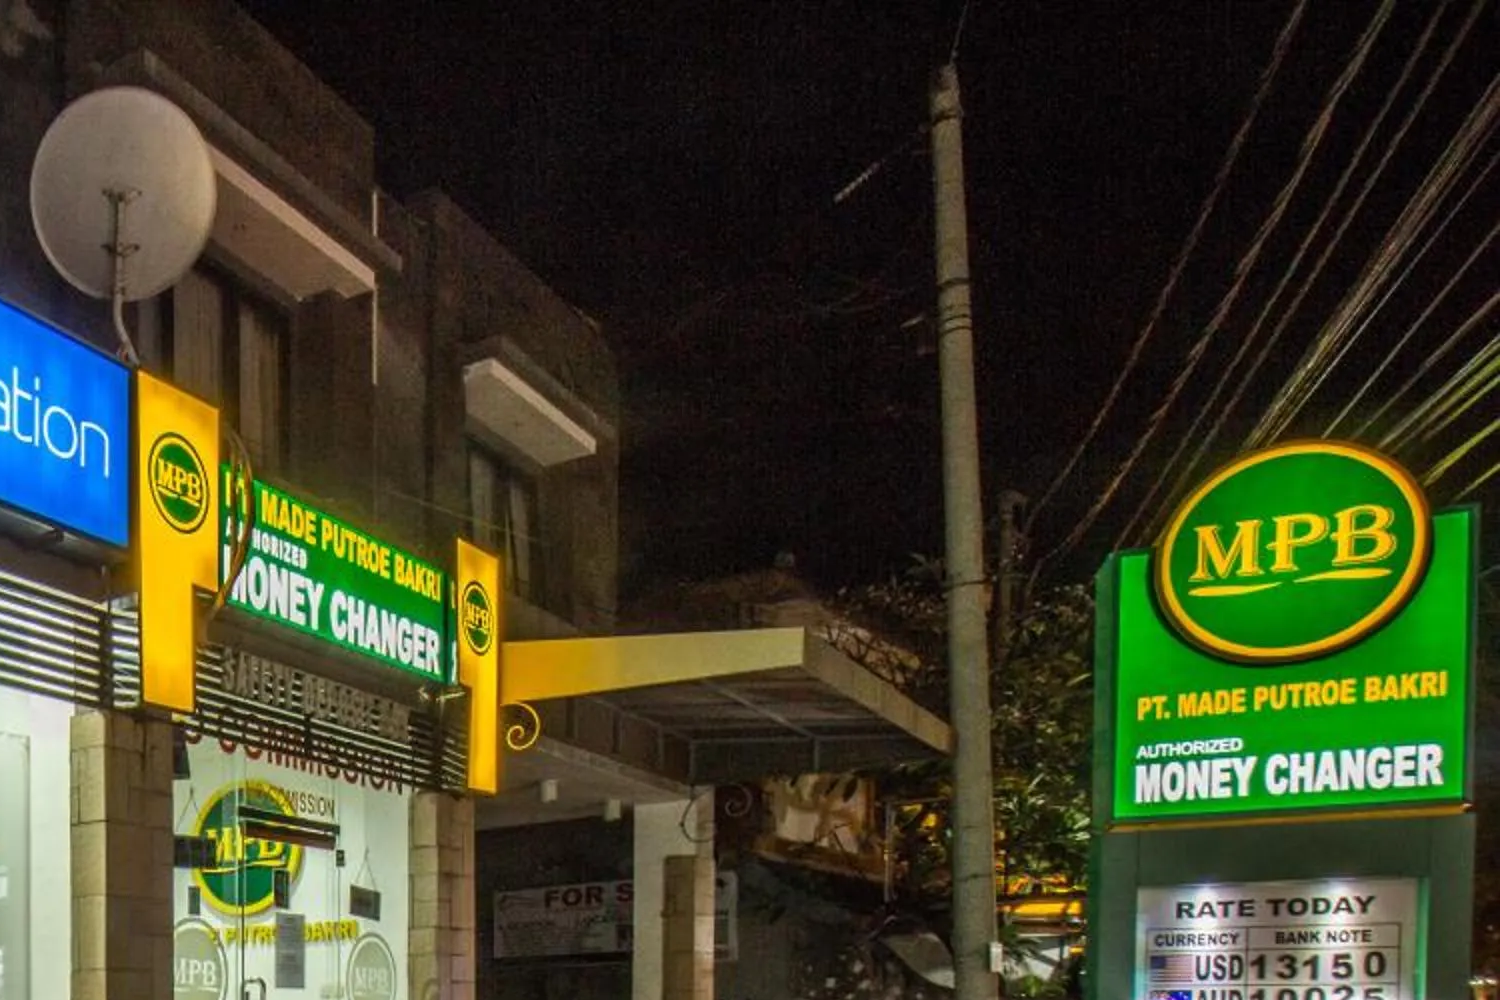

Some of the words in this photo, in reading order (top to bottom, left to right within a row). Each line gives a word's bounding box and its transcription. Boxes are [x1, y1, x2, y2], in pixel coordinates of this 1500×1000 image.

[156, 459, 203, 500] MPB
[261, 489, 317, 545] MADE
[321, 518, 391, 579] PUTROE
[394, 551, 442, 602] BAKRI
[1188, 503, 1398, 583] MPB
[224, 543, 325, 631] MONEY
[329, 588, 442, 677] CHANGER
[464, 601, 491, 632] MPB
[1136, 696, 1171, 721] PT.
[1177, 688, 1247, 719] MADE
[1253, 678, 1357, 711] PUTROE
[1363, 671, 1448, 702] BAKRI
[1136, 737, 1244, 760] AUTHORIZED
[1134, 756, 1257, 804] MONEY
[1264, 743, 1444, 795] CHANGER
[544, 885, 603, 909] FOR
[1176, 900, 1255, 920] RATE
[1267, 895, 1377, 917] TODAY
[1154, 932, 1240, 948] CURRENCY
[1275, 930, 1320, 945] BANK
[1326, 929, 1373, 944] NOTE
[1195, 954, 1243, 981] USD
[1250, 951, 1386, 981] 13150
